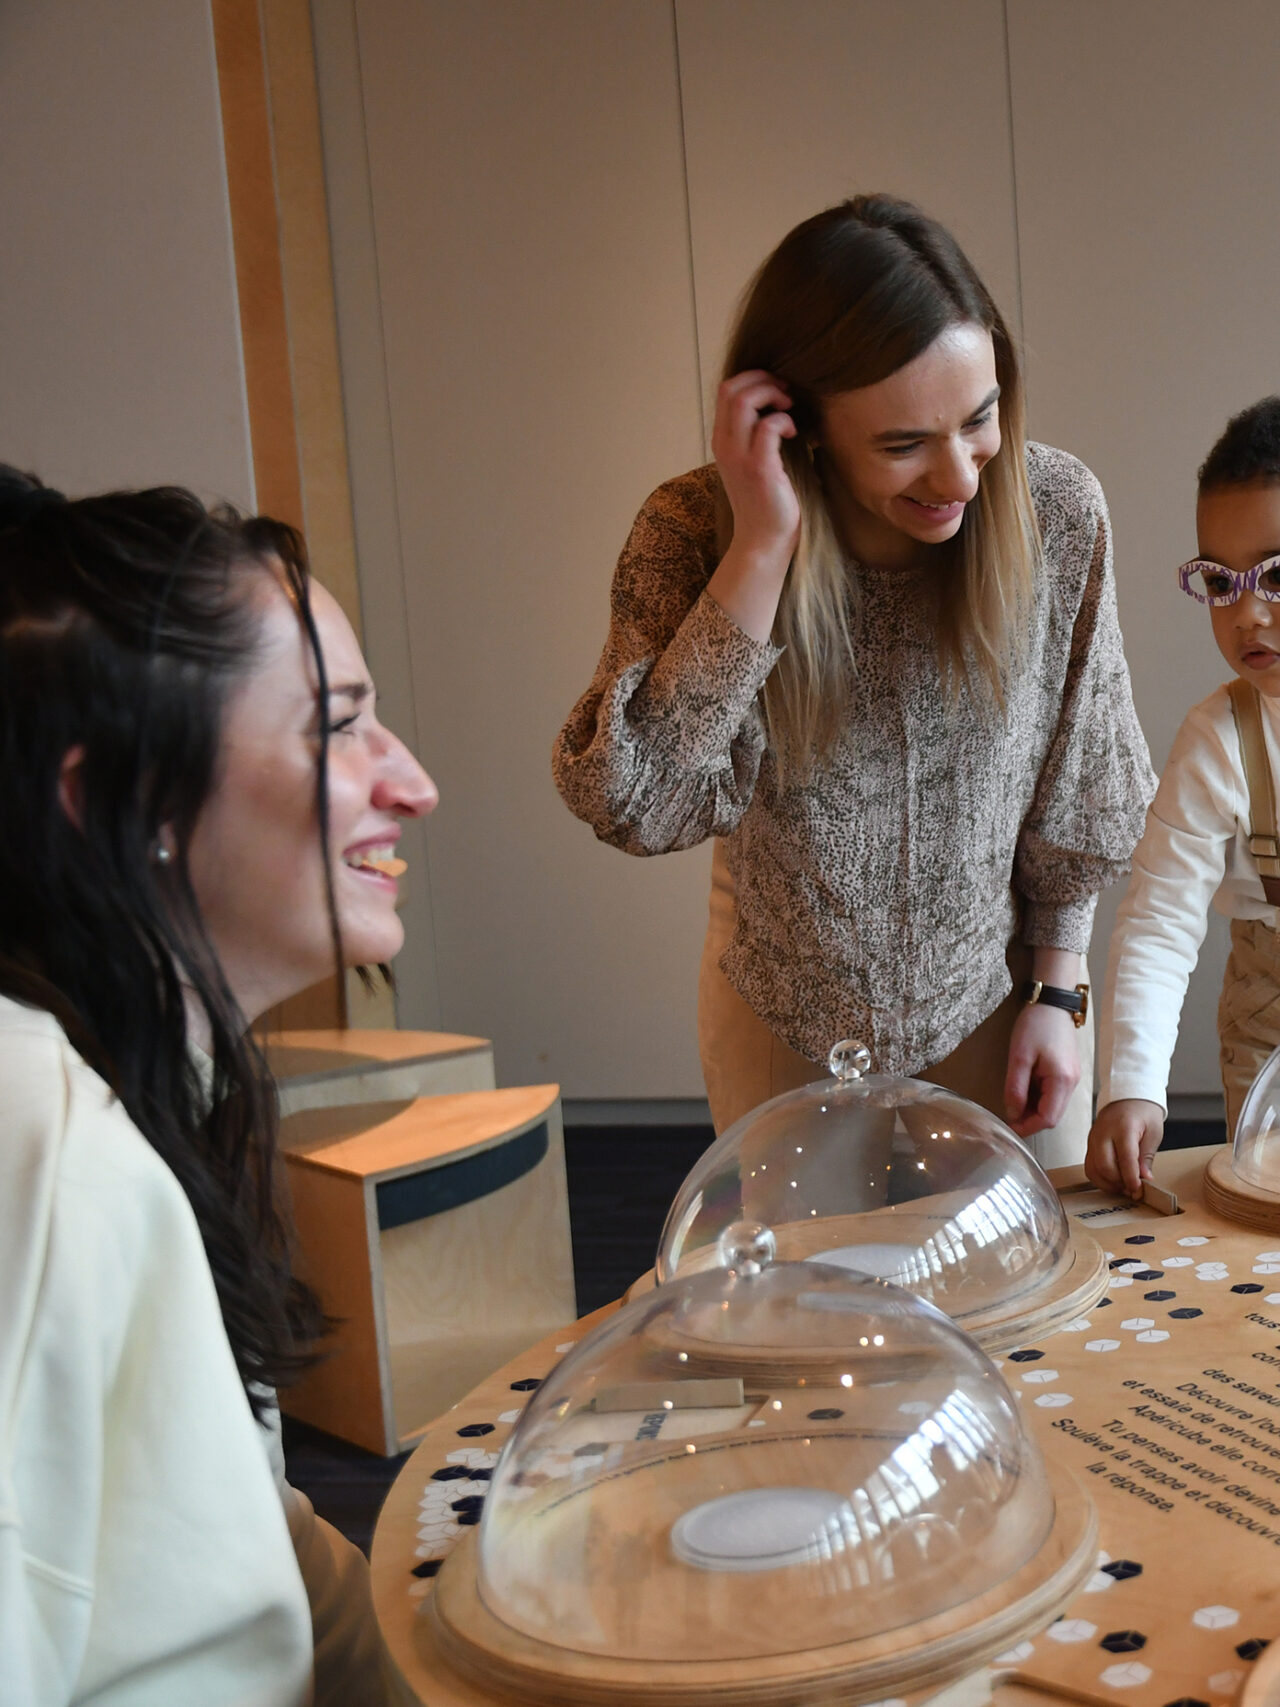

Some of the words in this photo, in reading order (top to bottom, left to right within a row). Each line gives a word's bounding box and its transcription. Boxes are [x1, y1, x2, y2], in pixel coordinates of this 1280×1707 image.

[1244, 1312, 1280, 1329] tous
[1202, 1368, 1235, 1384] des
[1122, 1378, 1145, 1390] et
[1139, 1387, 1193, 1414] essaie
[1190, 1410, 1216, 1424] de
[1176, 1382, 1254, 1420] Découvre
[1101, 1418, 1127, 1433] Tu
[1117, 1431, 1185, 1463] penses
[1180, 1462, 1229, 1485] avoir
[1128, 1404, 1213, 1446] Apéricube
[1209, 1444, 1245, 1462] elle
[1051, 1418, 1115, 1452] Soulève
[1110, 1449, 1132, 1461] la
[1128, 1459, 1188, 1490] trappe
[1184, 1489, 1211, 1501] et
[1085, 1461, 1107, 1474] la
[1102, 1472, 1175, 1513] réponse.
